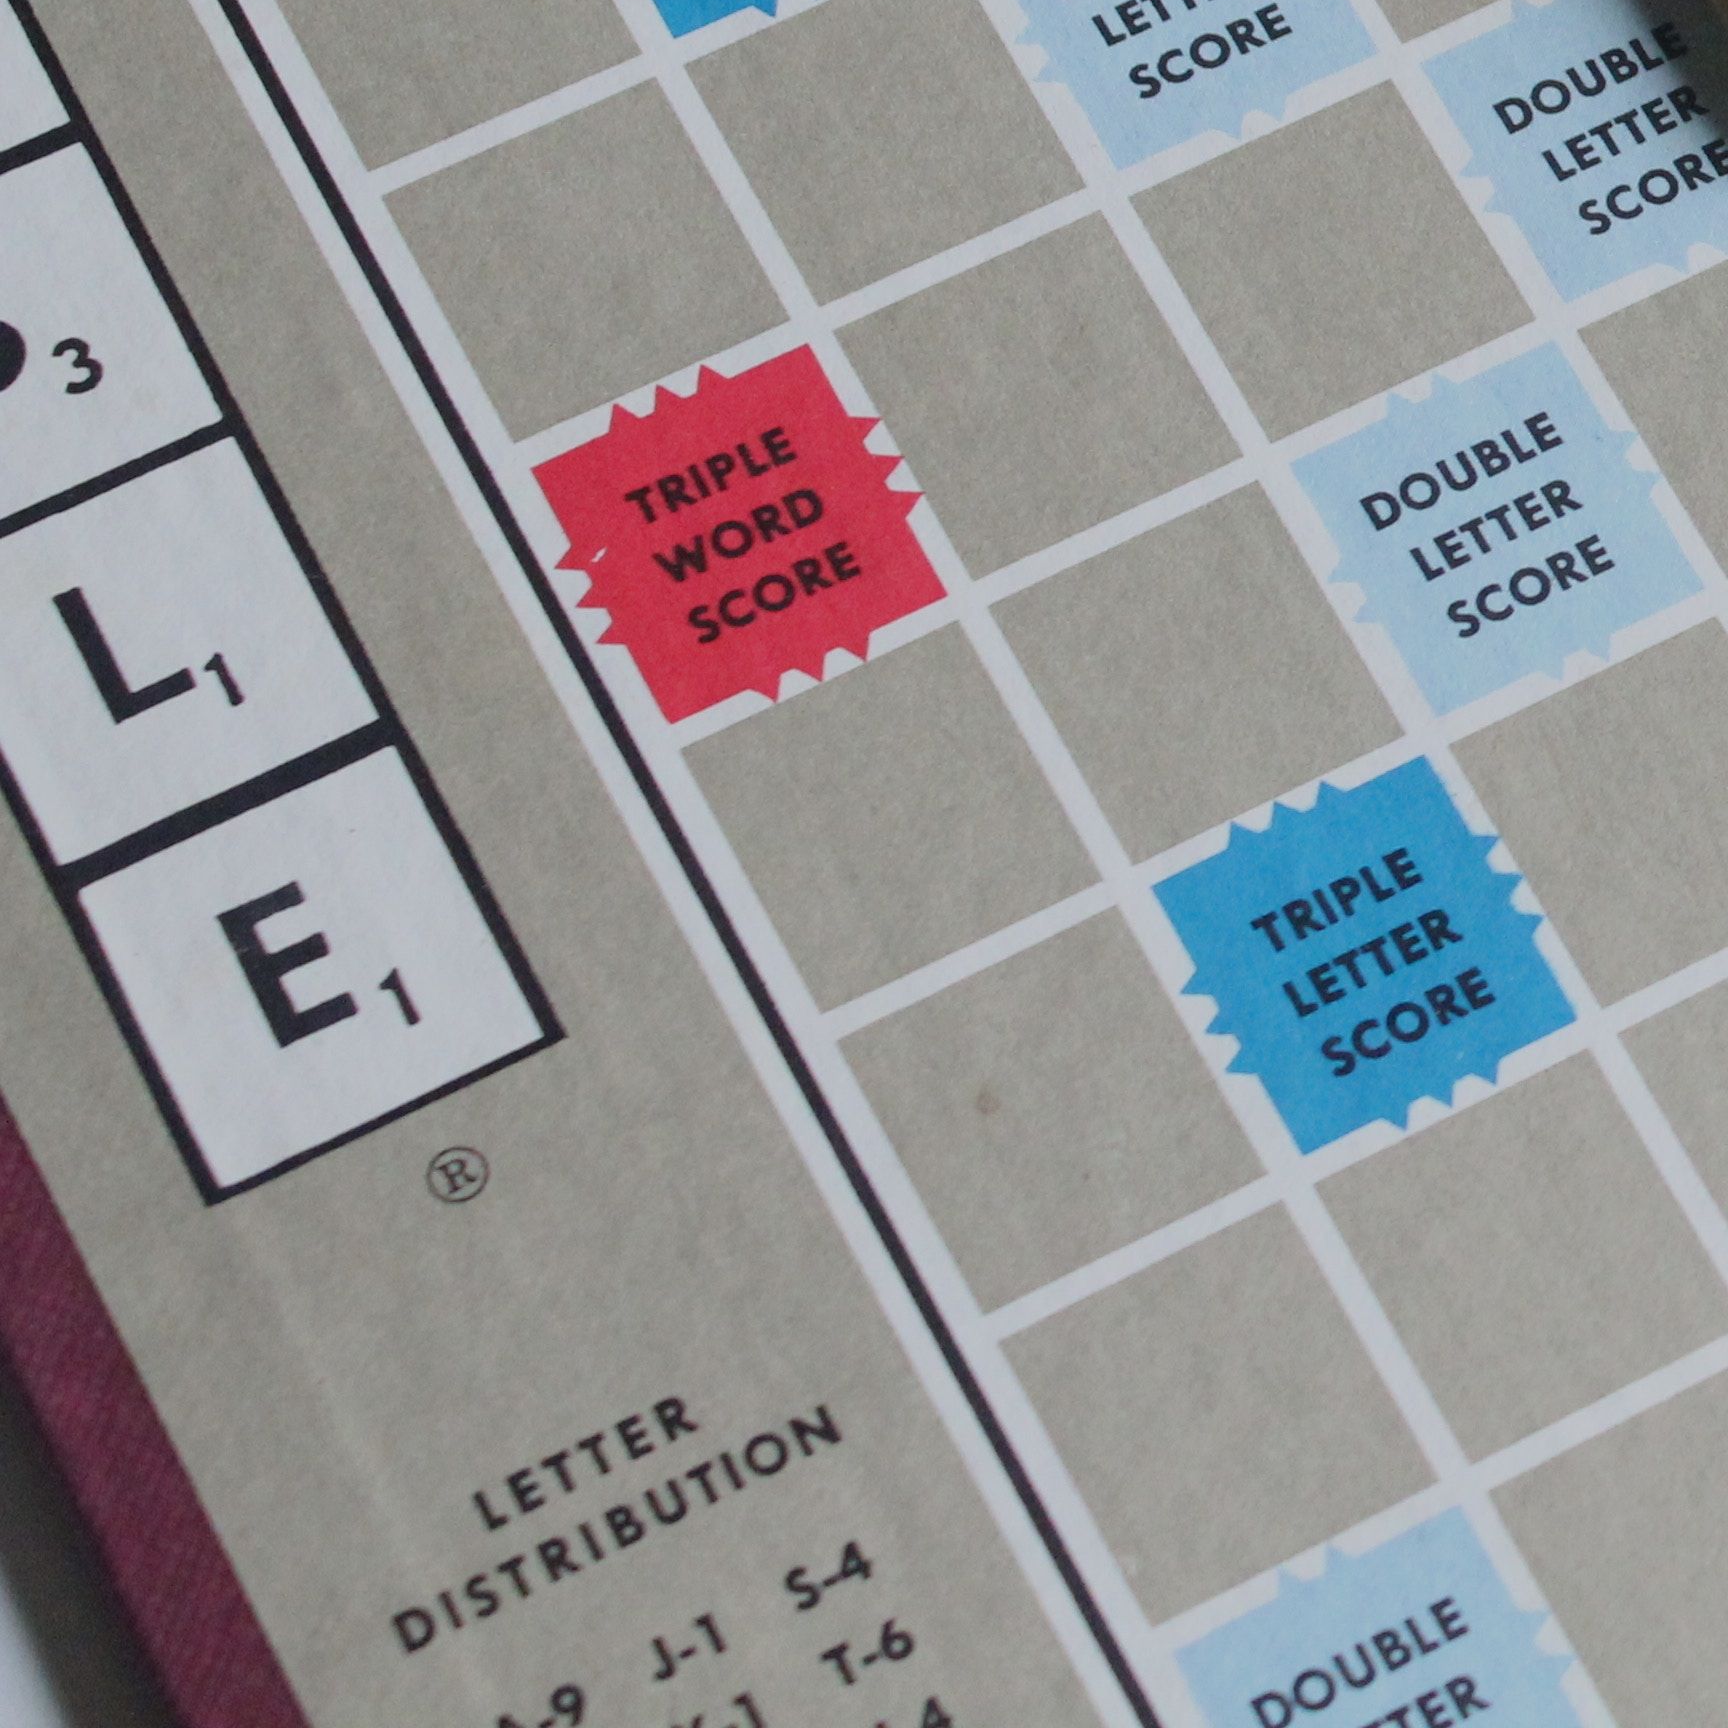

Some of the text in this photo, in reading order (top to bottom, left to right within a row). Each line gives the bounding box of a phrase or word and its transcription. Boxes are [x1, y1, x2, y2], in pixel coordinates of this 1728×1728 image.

[1127, 1, 1294, 101] SCORE
[1491, 20, 1691, 136] DOUBLE
[1540, 85, 1711, 183] LETTER
[622, 425, 799, 525] TRIPLE
[1358, 410, 1565, 533] DOUBLE
[651, 487, 825, 584] WORD
[1408, 478, 1584, 583] LETTER
[686, 540, 863, 646] SCORE
[1445, 533, 1617, 640] SCORE
[1248, 846, 1425, 953] TRIPLE
[1281, 908, 1465, 1019] LETTER
[1319, 966, 1497, 1078] SCORE
[473, 1395, 700, 1532] LETTER
[392, 1403, 843, 1654] DISTRIBUTION
[650, 1614, 726, 1681] J-1
[784, 1541, 873, 1611] S-4
[820, 1619, 914, 1686] T-6
[1248, 1596, 1470, 1728] DOUBLE
